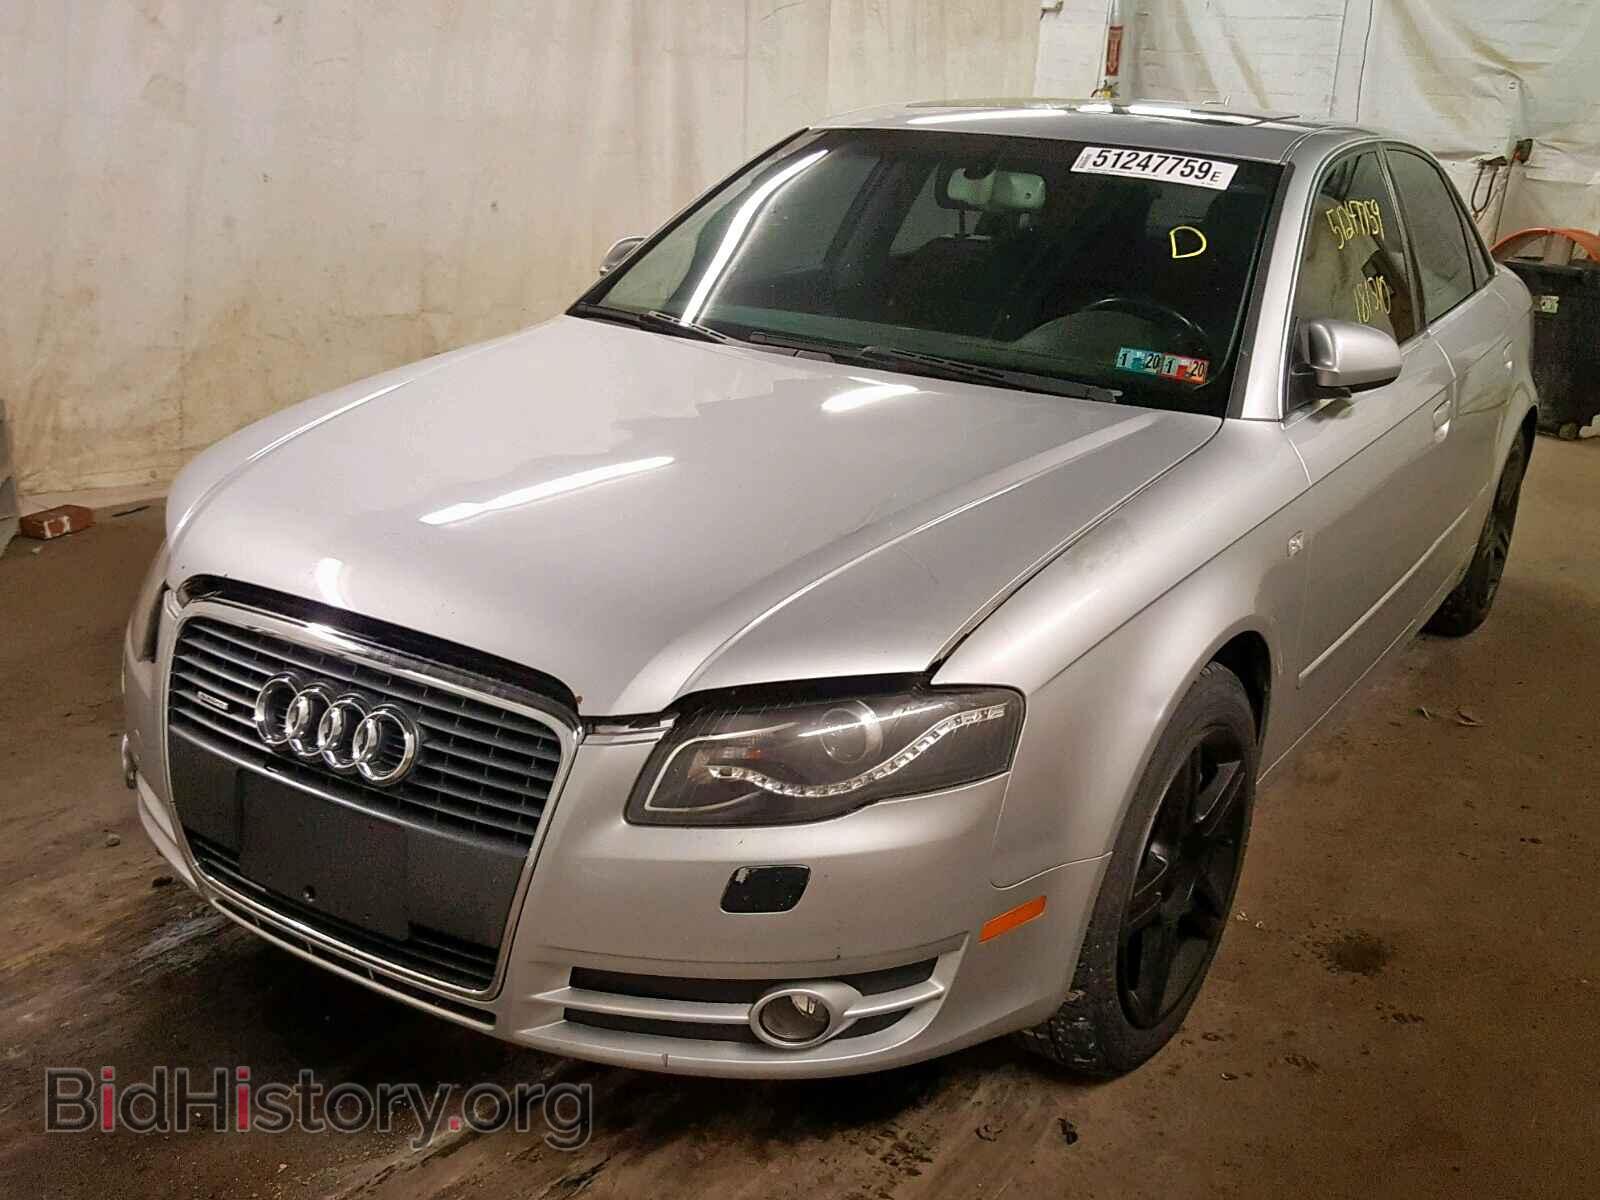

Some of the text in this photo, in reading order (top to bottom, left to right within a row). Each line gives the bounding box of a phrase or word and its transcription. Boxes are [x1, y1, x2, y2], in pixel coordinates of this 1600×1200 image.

[1092, 150, 1213, 181] 51247759
[1209, 171, 1222, 183] E
[1169, 225, 1207, 259] D
[1119, 352, 1160, 370] 1 20
[1165, 359, 1205, 377] 1 20
